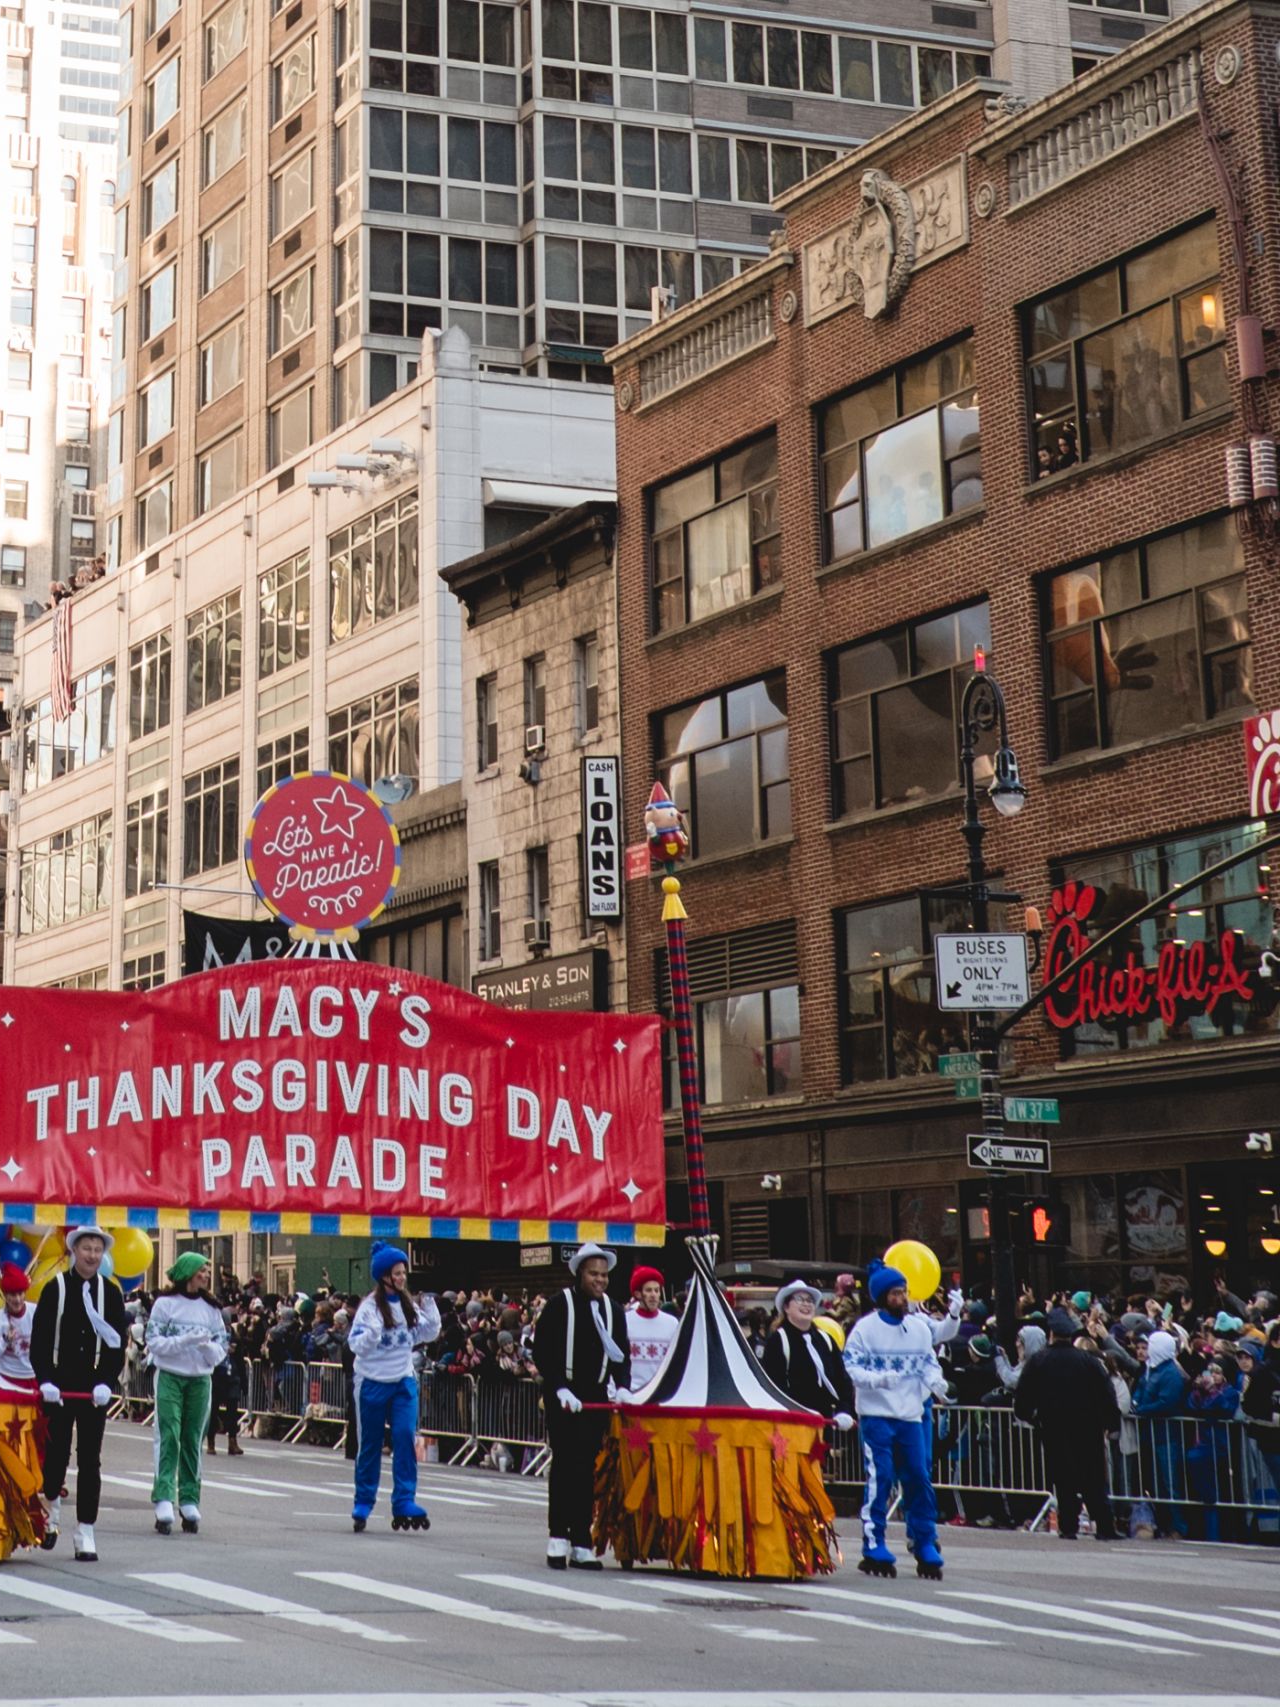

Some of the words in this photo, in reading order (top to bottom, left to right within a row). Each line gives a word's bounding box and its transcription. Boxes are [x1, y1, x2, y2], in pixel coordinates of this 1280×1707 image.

[588, 763, 613, 773] CASH
[263, 815, 312, 857] Let's
[590, 777, 615, 896] LOANS
[302, 845, 335, 864] HAVE
[341, 842, 350, 855] A
[273, 840, 383, 898] Parade!
[601, 902, 616, 912] FLOOR
[956, 941, 1006, 954] BUSES
[478, 976, 539, 1001] STANLEY
[542, 973, 551, 989] &
[556, 965, 589, 986] SON
[963, 966, 1002, 980] ONLY
[976, 982, 993, 990] 4PM
[1002, 983, 1018, 991] 7PM
[27, 1058, 472, 1140] THANKSGIVING
[507, 1084, 612, 1161] DAY
[1016, 1101, 1027, 1119] W
[1030, 1102, 1042, 1119] 37
[1045, 1102, 1055, 1112] ST
[980, 1146, 1003, 1159] ONE
[1014, 1149, 1038, 1161] WAY
[201, 1135, 447, 1200] PARADE
